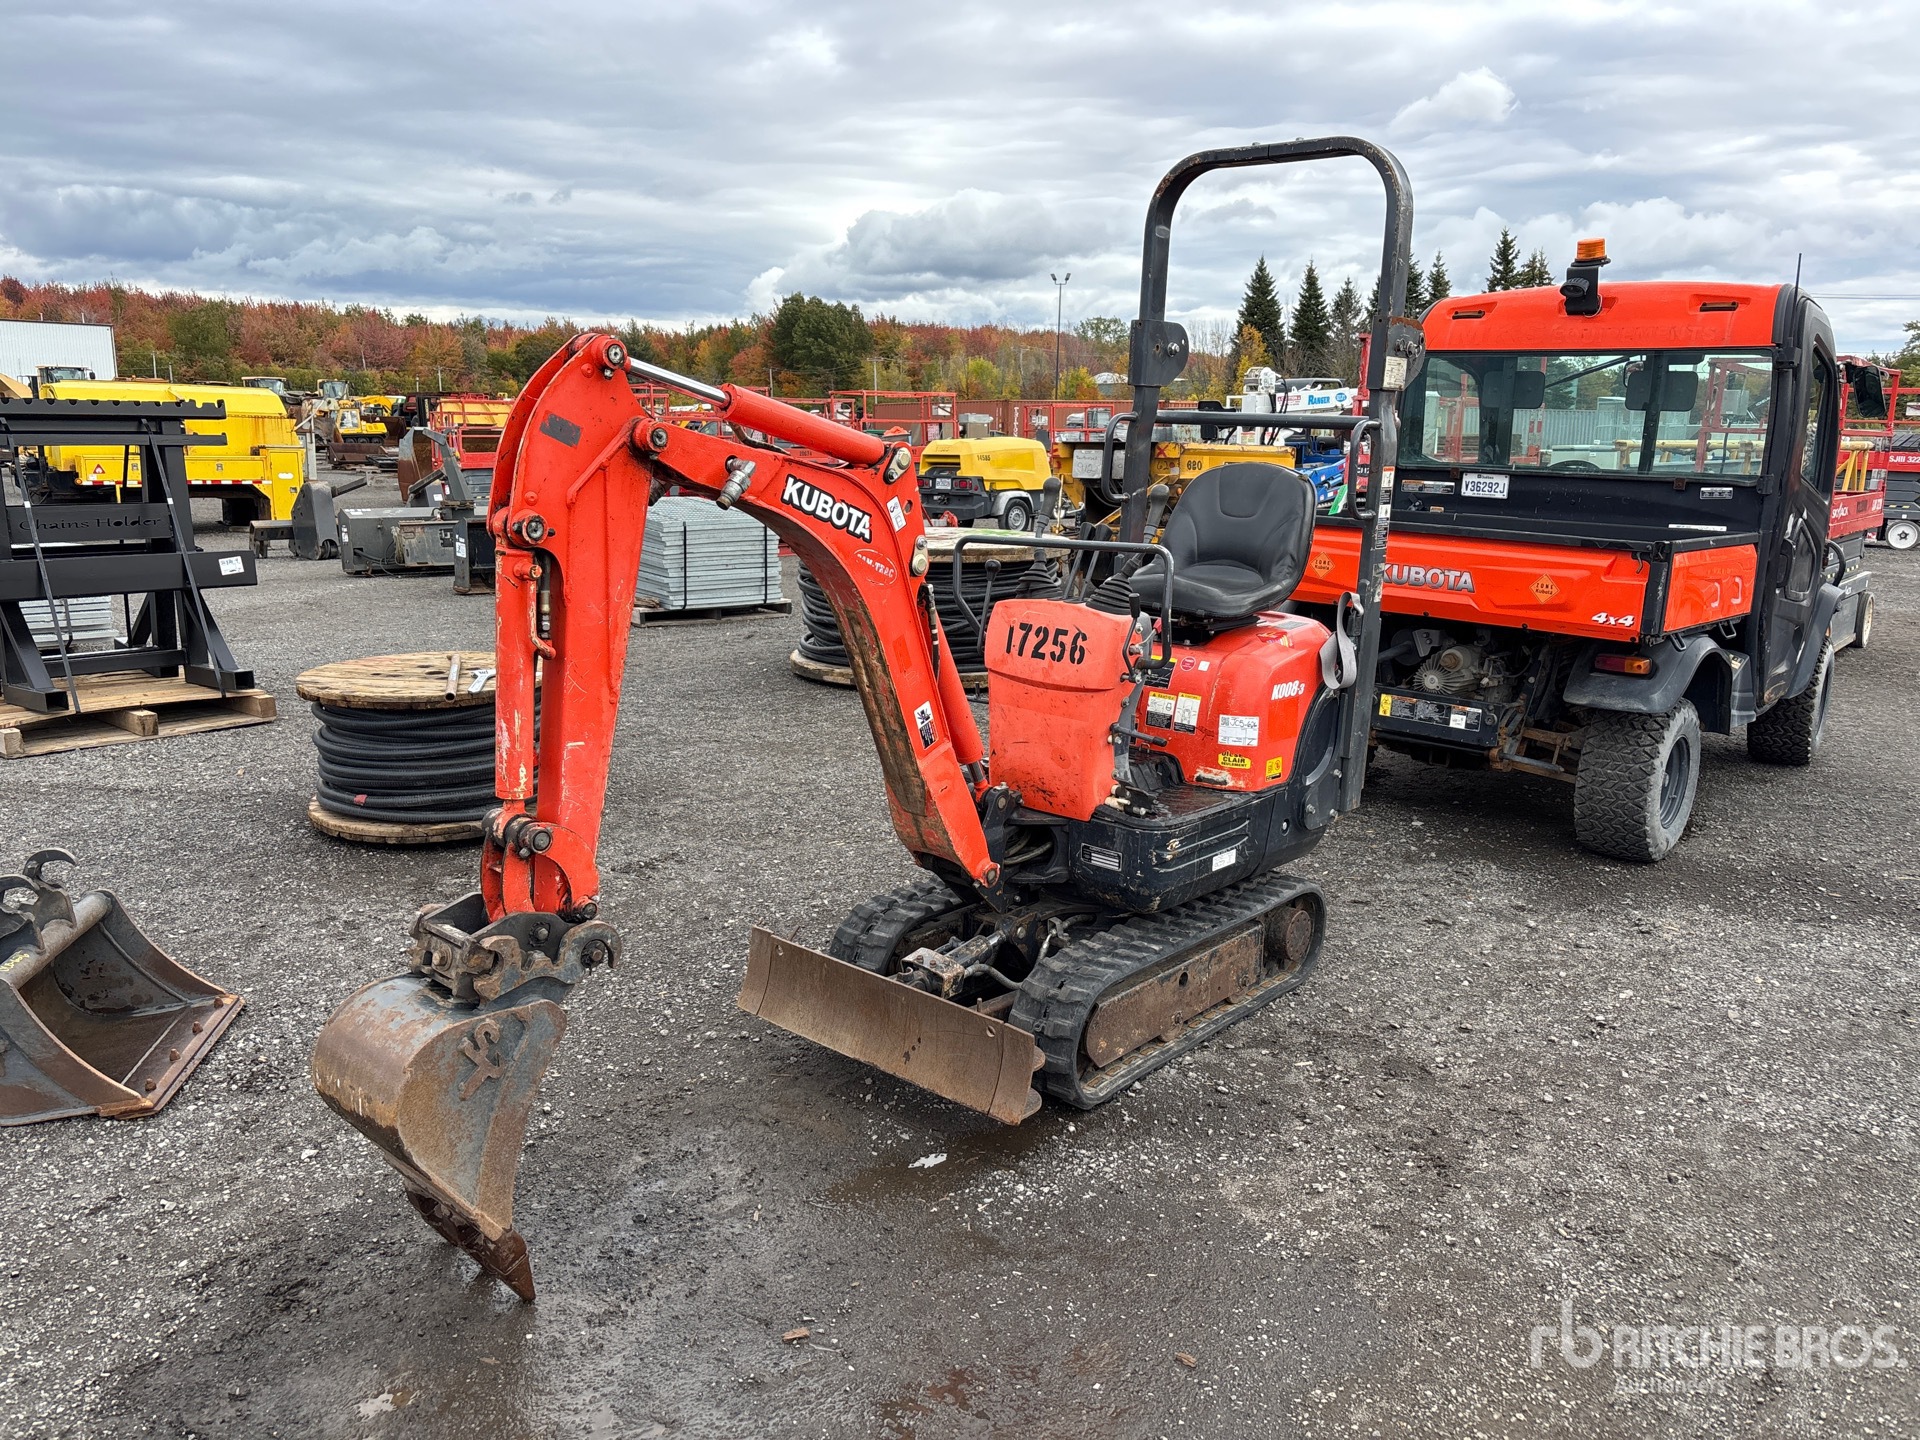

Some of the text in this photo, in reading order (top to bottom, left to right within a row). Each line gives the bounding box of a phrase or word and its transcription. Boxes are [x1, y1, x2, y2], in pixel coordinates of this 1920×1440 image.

[1307, 394, 1331, 405] RANGER
[1464, 480, 1506, 494] V36292J
[782, 475, 871, 541] KUBOTA
[19, 515, 161, 531] Chains Holder
[1383, 563, 1476, 593] KUBOTA
[1535, 582, 1554, 590] ZONE
[1591, 612, 1636, 627] 4x4
[1005, 622, 1088, 665] 17256
[1270, 680, 1306, 701] K008-3
[1222, 756, 1246, 764] CLAIR
